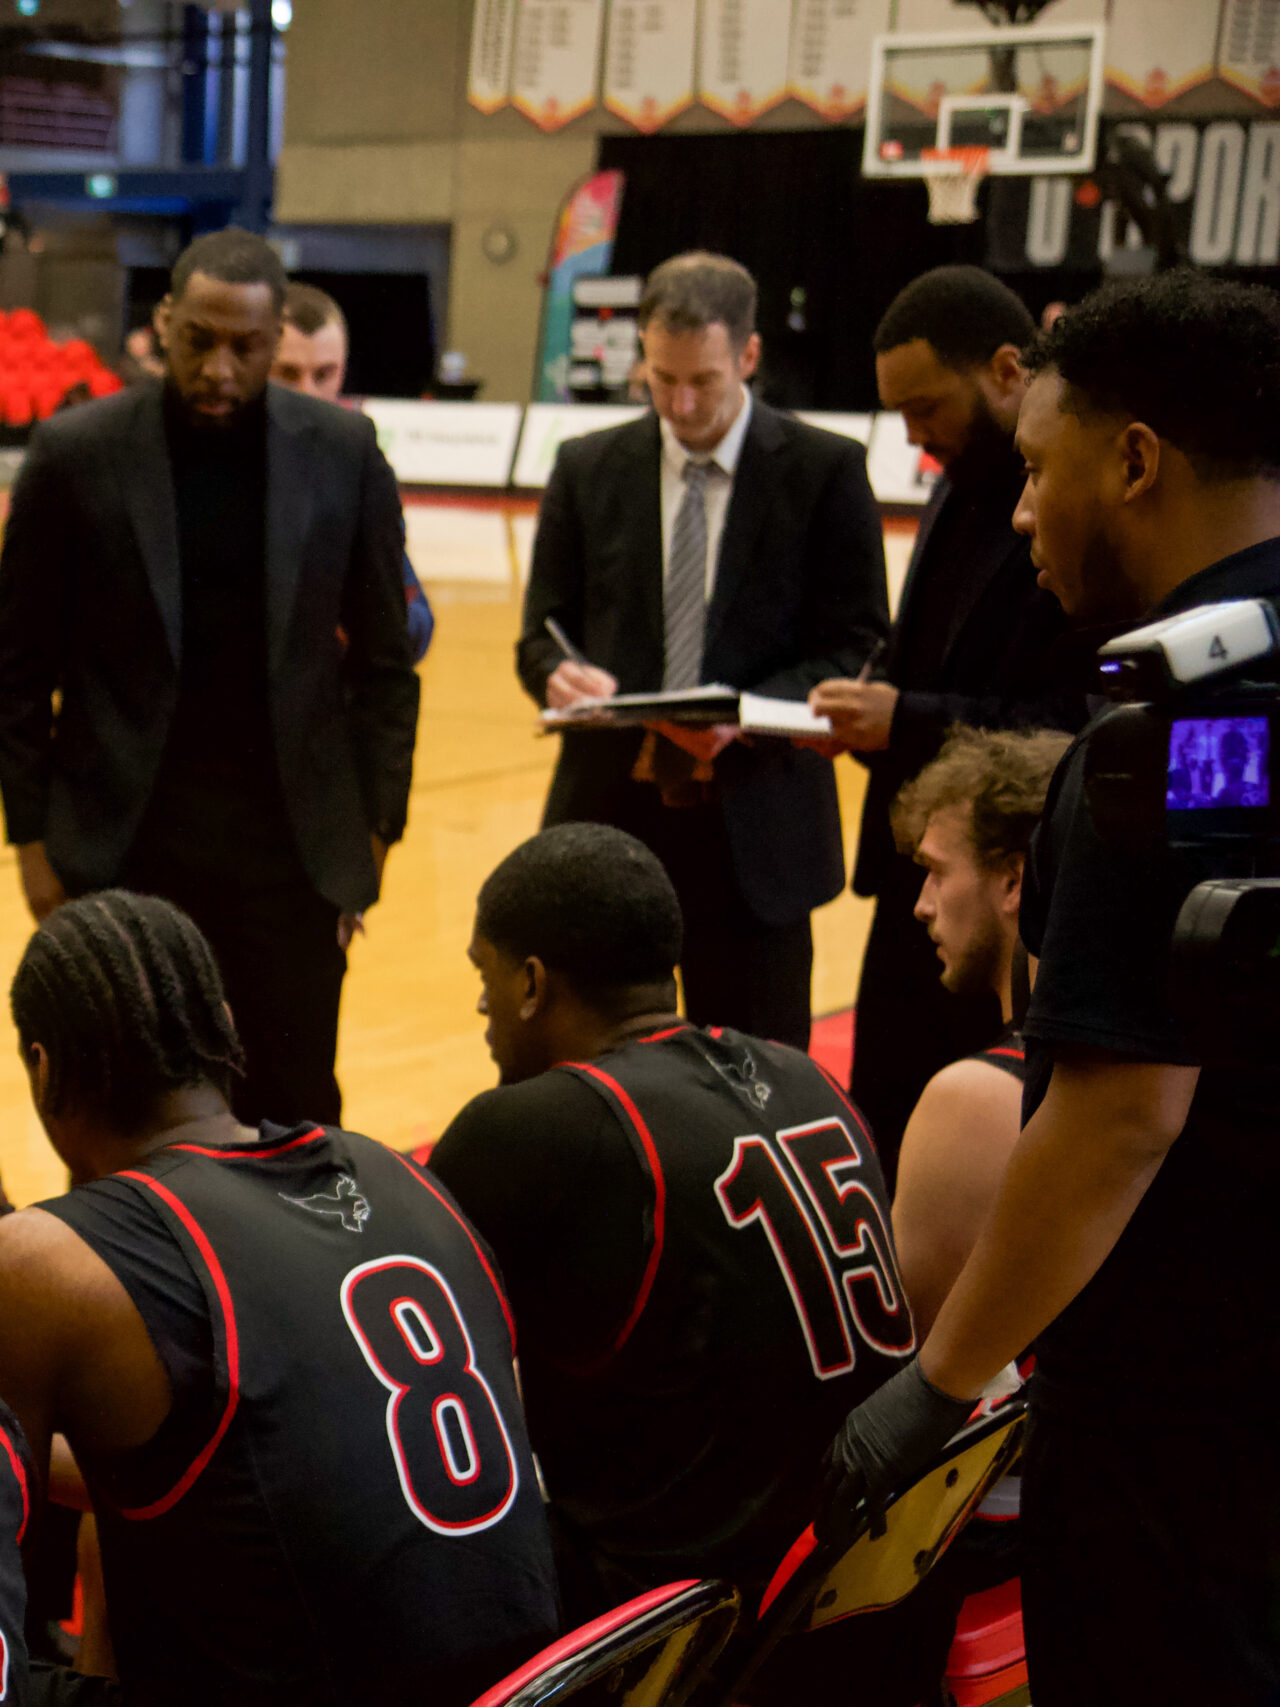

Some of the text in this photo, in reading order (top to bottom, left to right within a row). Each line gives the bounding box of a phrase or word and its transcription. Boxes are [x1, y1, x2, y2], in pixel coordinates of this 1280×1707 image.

[1208, 634, 1228, 660] 4
[713, 1116, 916, 1381] 15
[340, 1254, 518, 1536] 8
